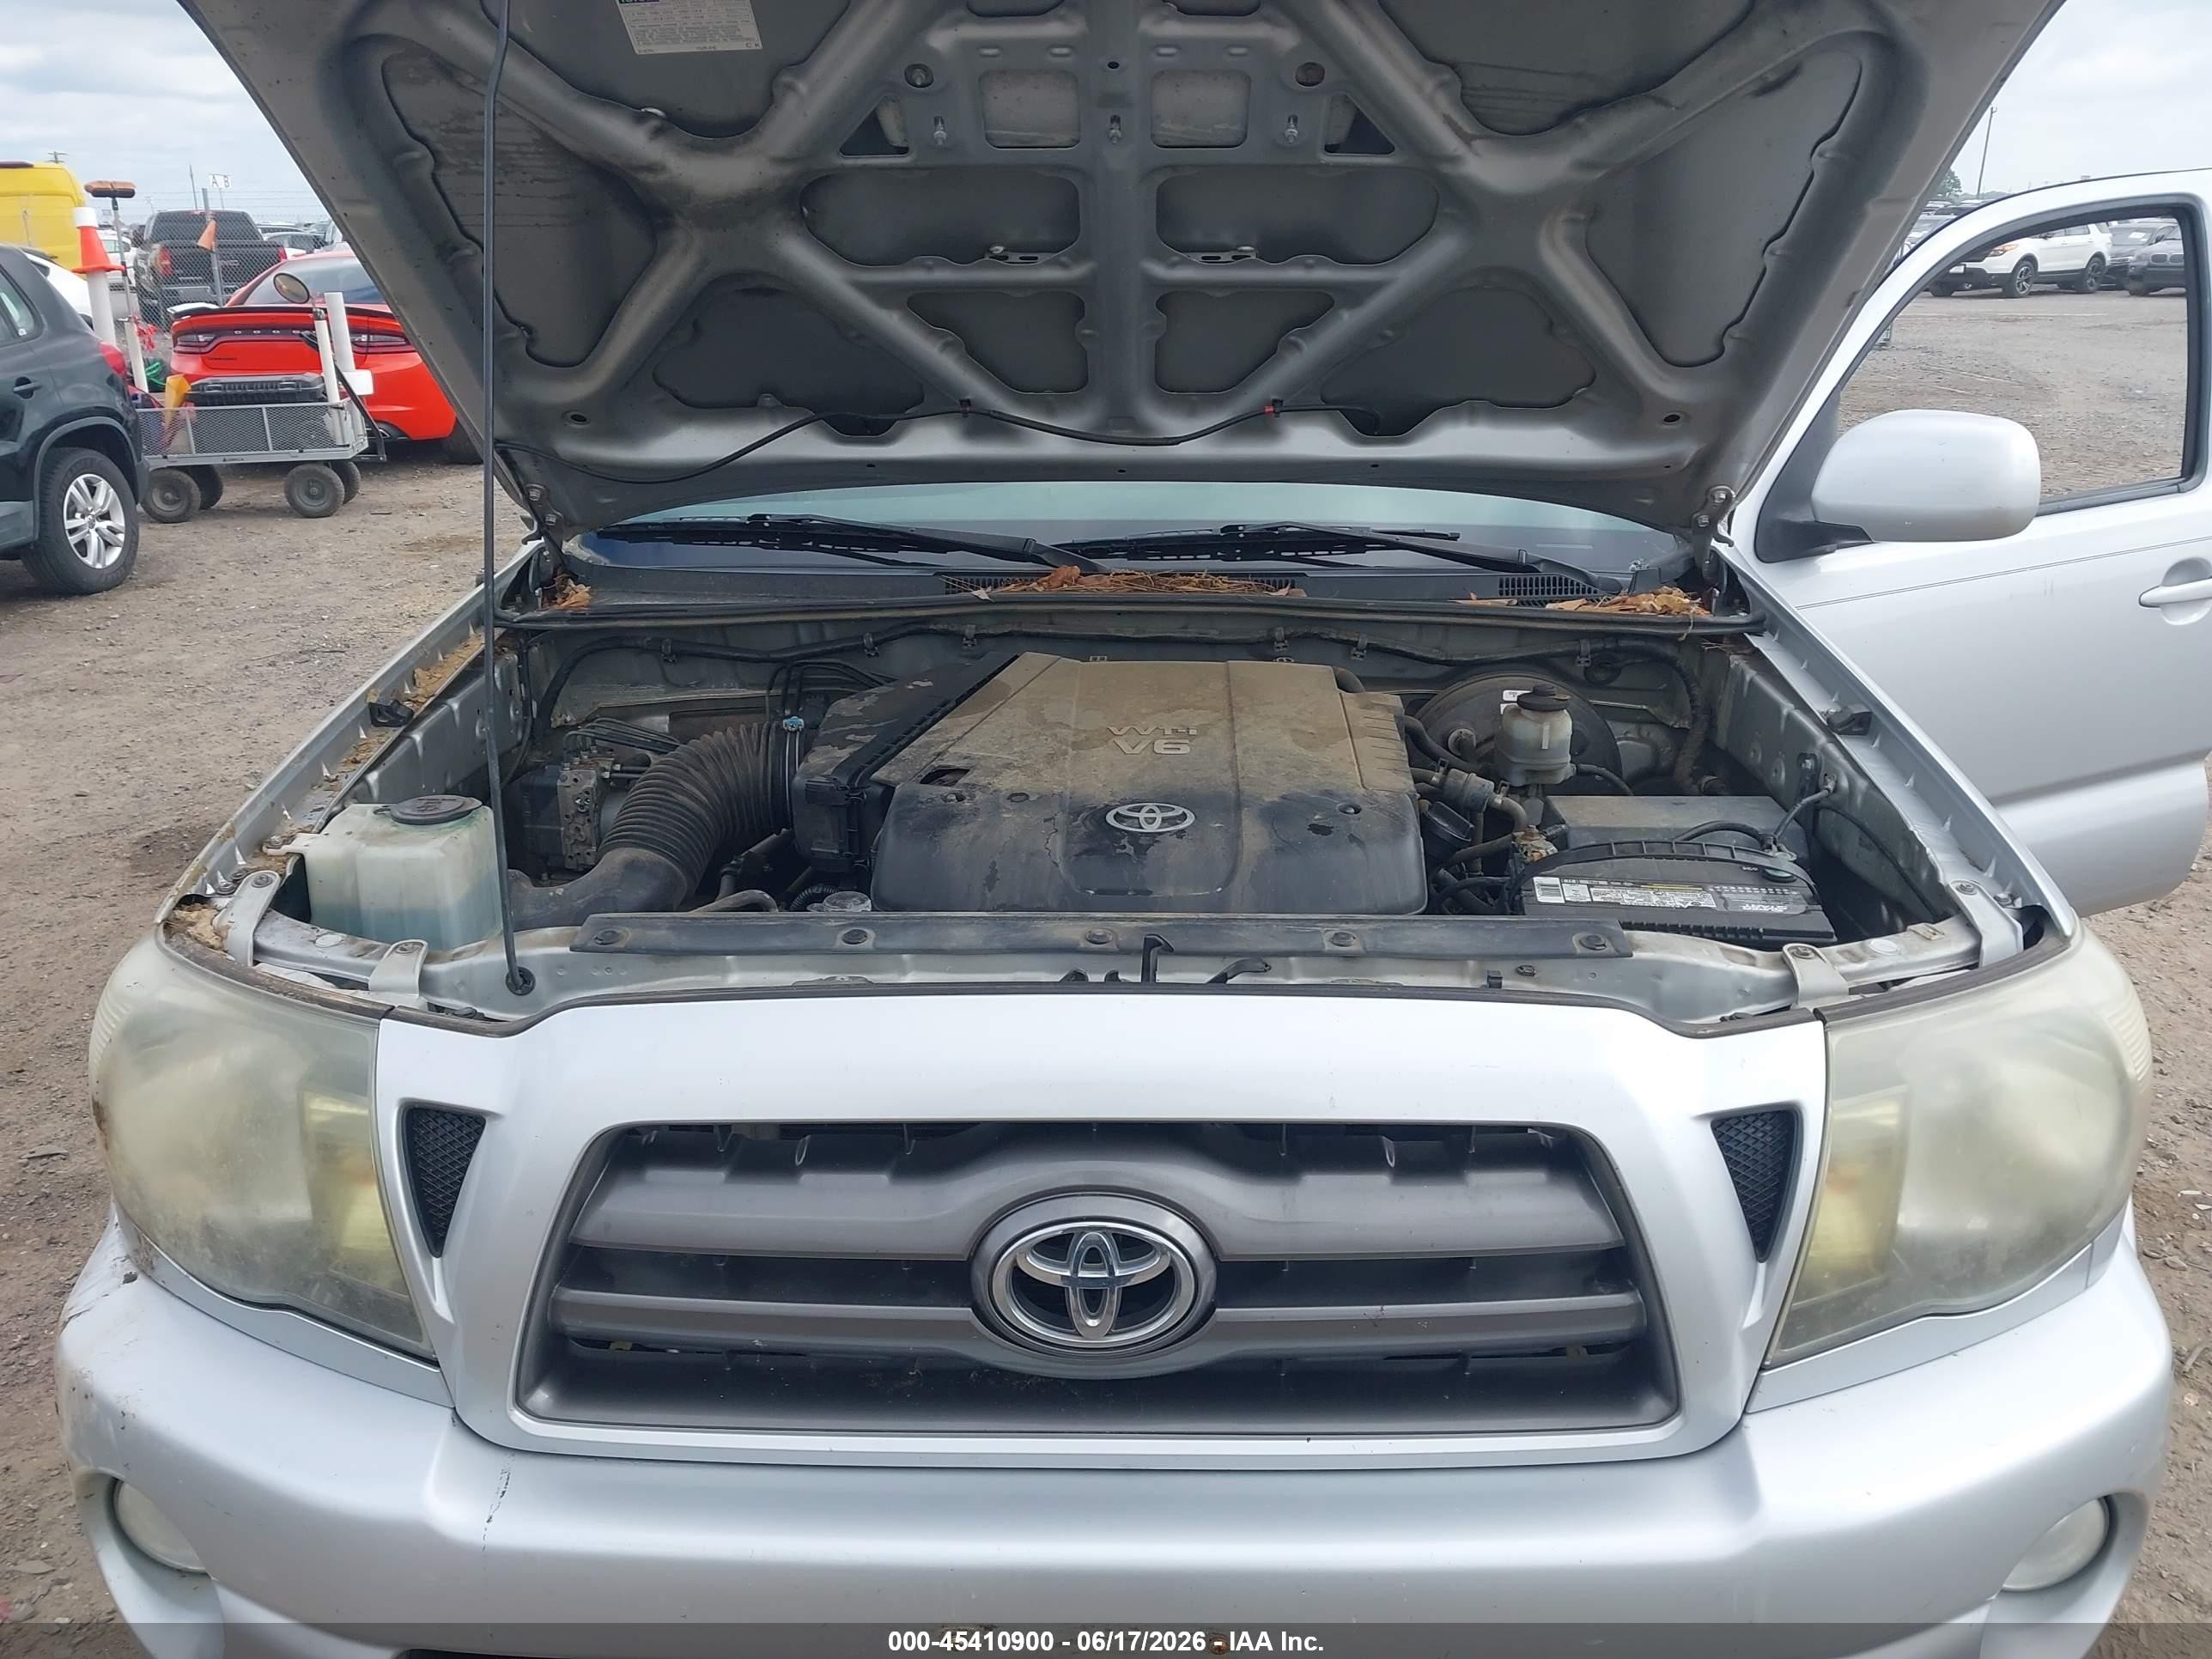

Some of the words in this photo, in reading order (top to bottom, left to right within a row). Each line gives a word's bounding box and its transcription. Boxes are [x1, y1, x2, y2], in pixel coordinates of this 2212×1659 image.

[212, 174, 219, 187] A
[224, 174, 230, 187] B
[1113, 738, 1191, 755] V6
